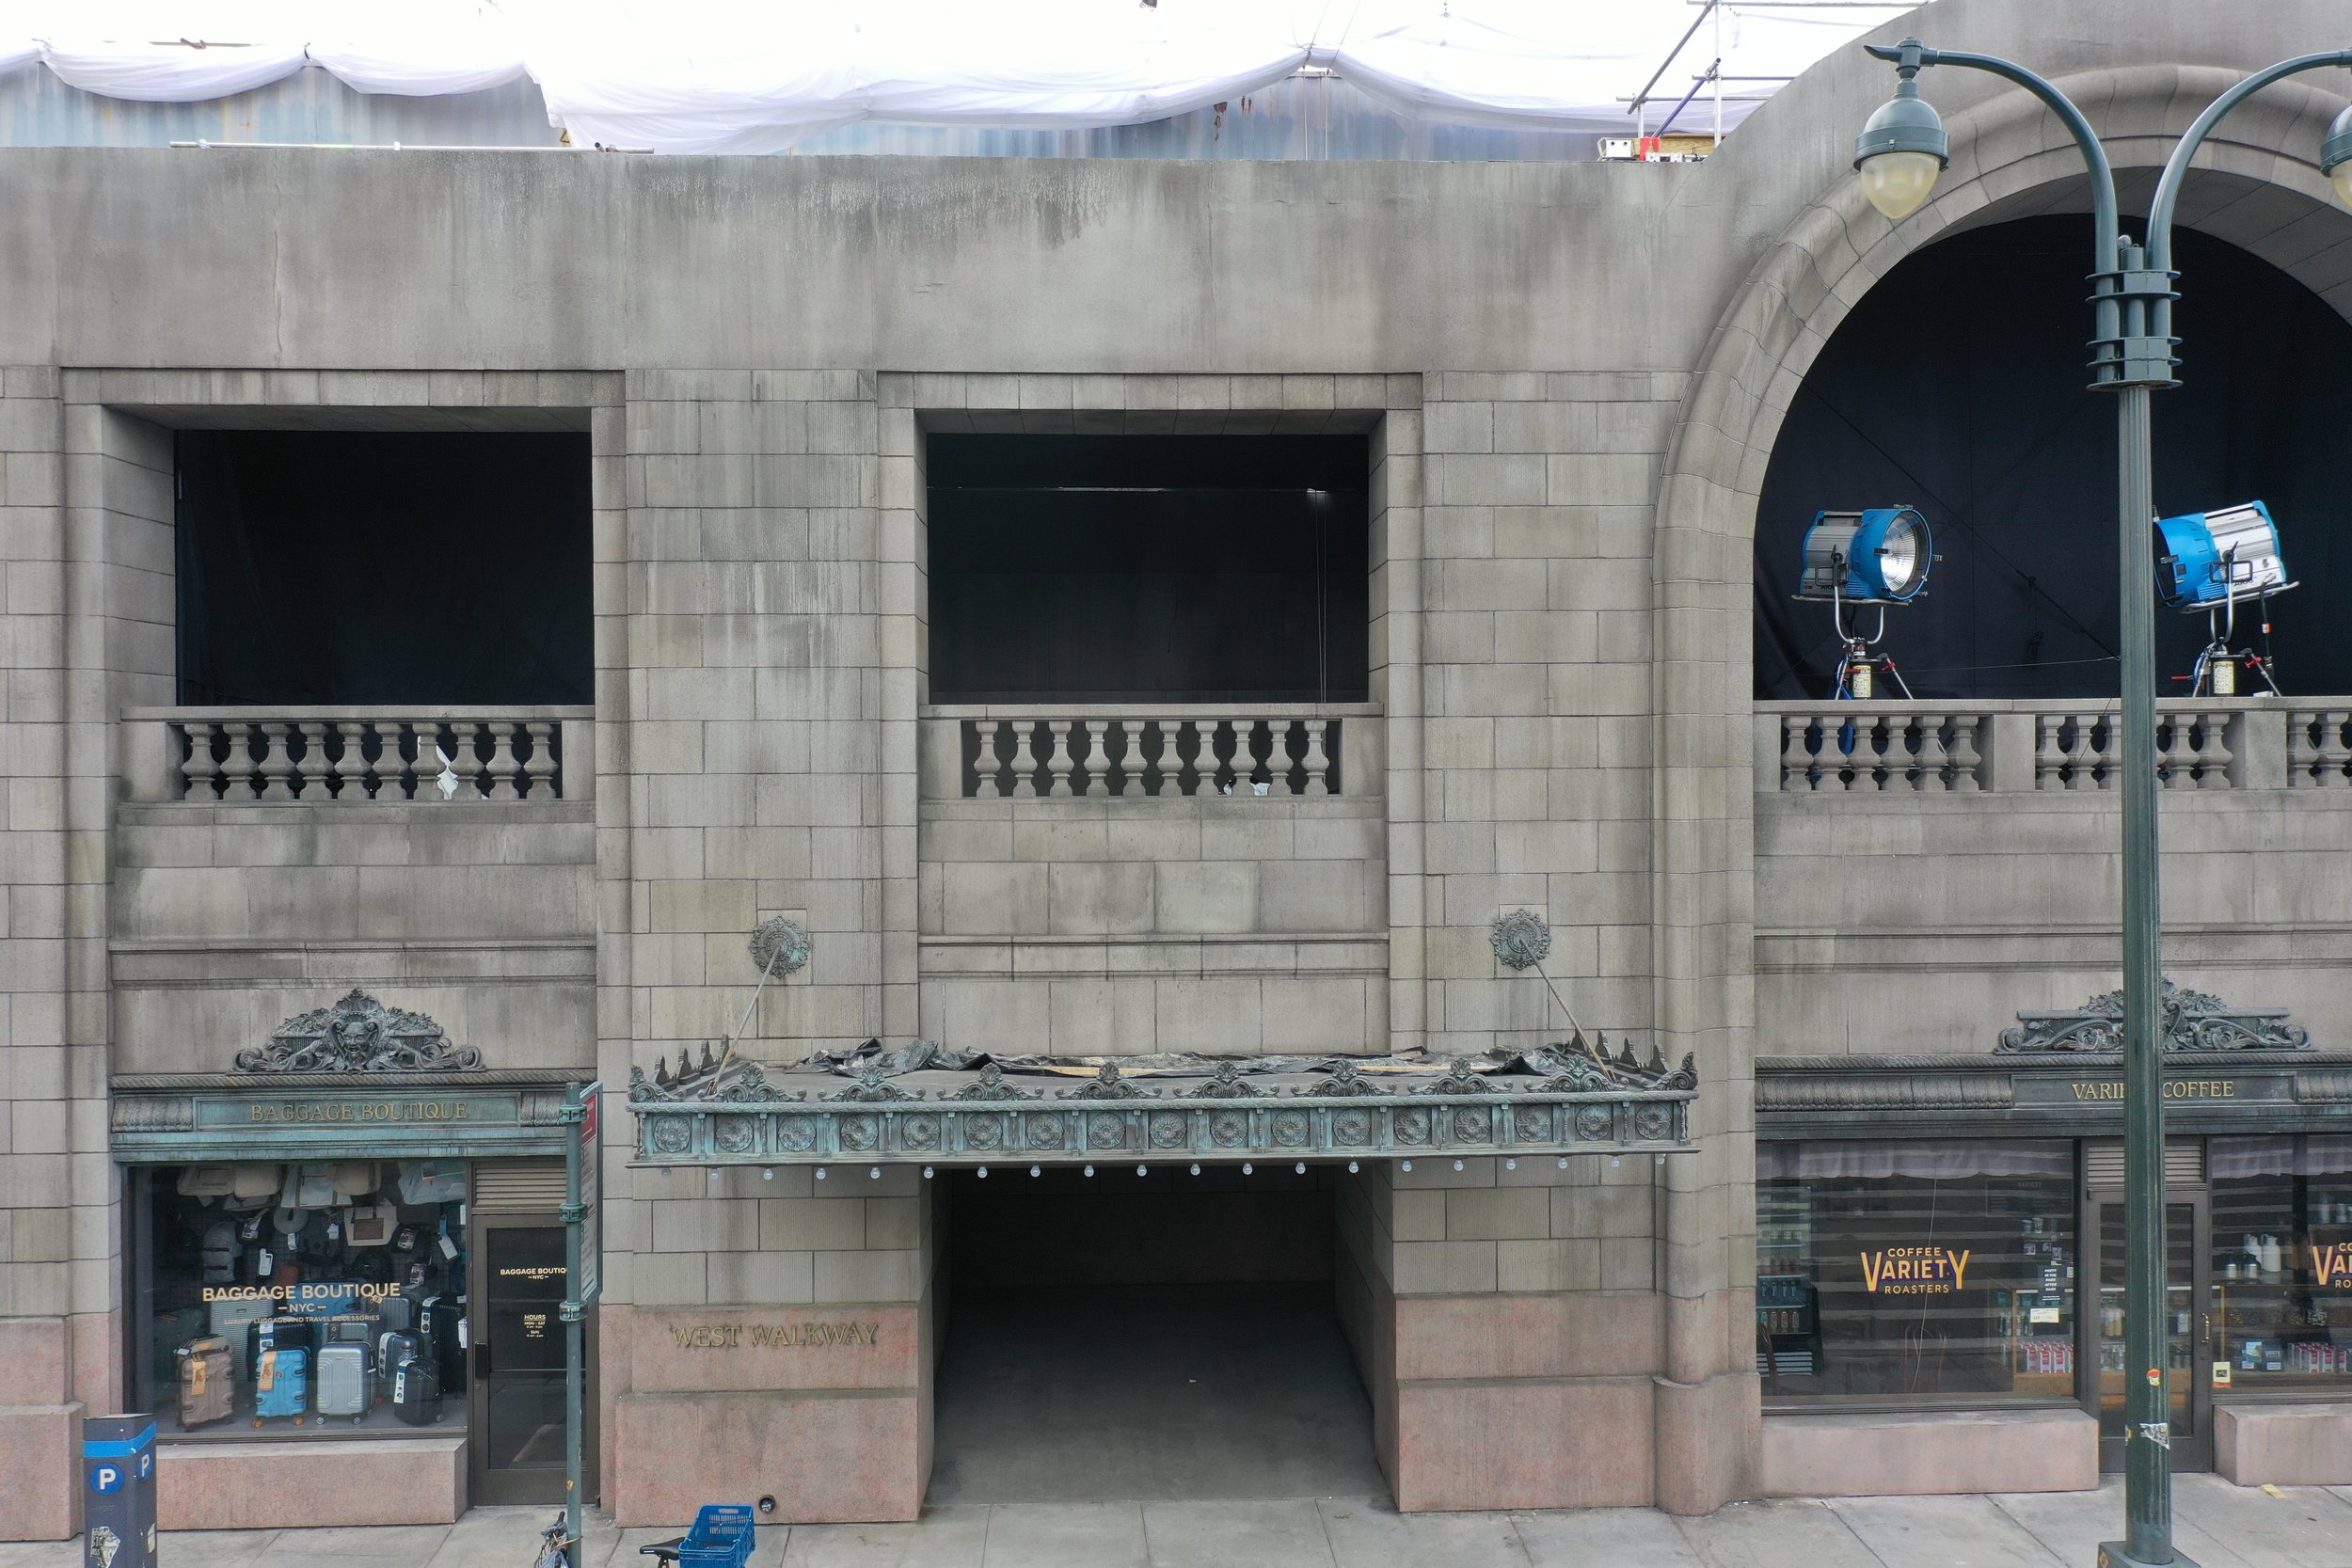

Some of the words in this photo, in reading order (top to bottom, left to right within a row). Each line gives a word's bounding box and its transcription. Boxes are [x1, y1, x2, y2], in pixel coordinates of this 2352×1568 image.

[2072, 1083, 2124, 1100] VARI
[2163, 1081, 2234, 1099] COFFEE
[250, 1104, 354, 1122] BAGGAGE
[360, 1101, 469, 1121] BOUTIQUE
[1887, 1247, 1942, 1258] COFFEE
[1860, 1249, 1970, 1292] VARIETY
[202, 1285, 296, 1302] BAGGAGE
[302, 1282, 401, 1299] BOUTIQUE
[1884, 1284, 1949, 1294] ROASTERS
[289, 1304, 315, 1313] NYC
[670, 1325, 741, 1348] WEST
[747, 1323, 879, 1347] WALKWAY
[141, 1453, 151, 1478] P
[99, 1468, 117, 1490] P
